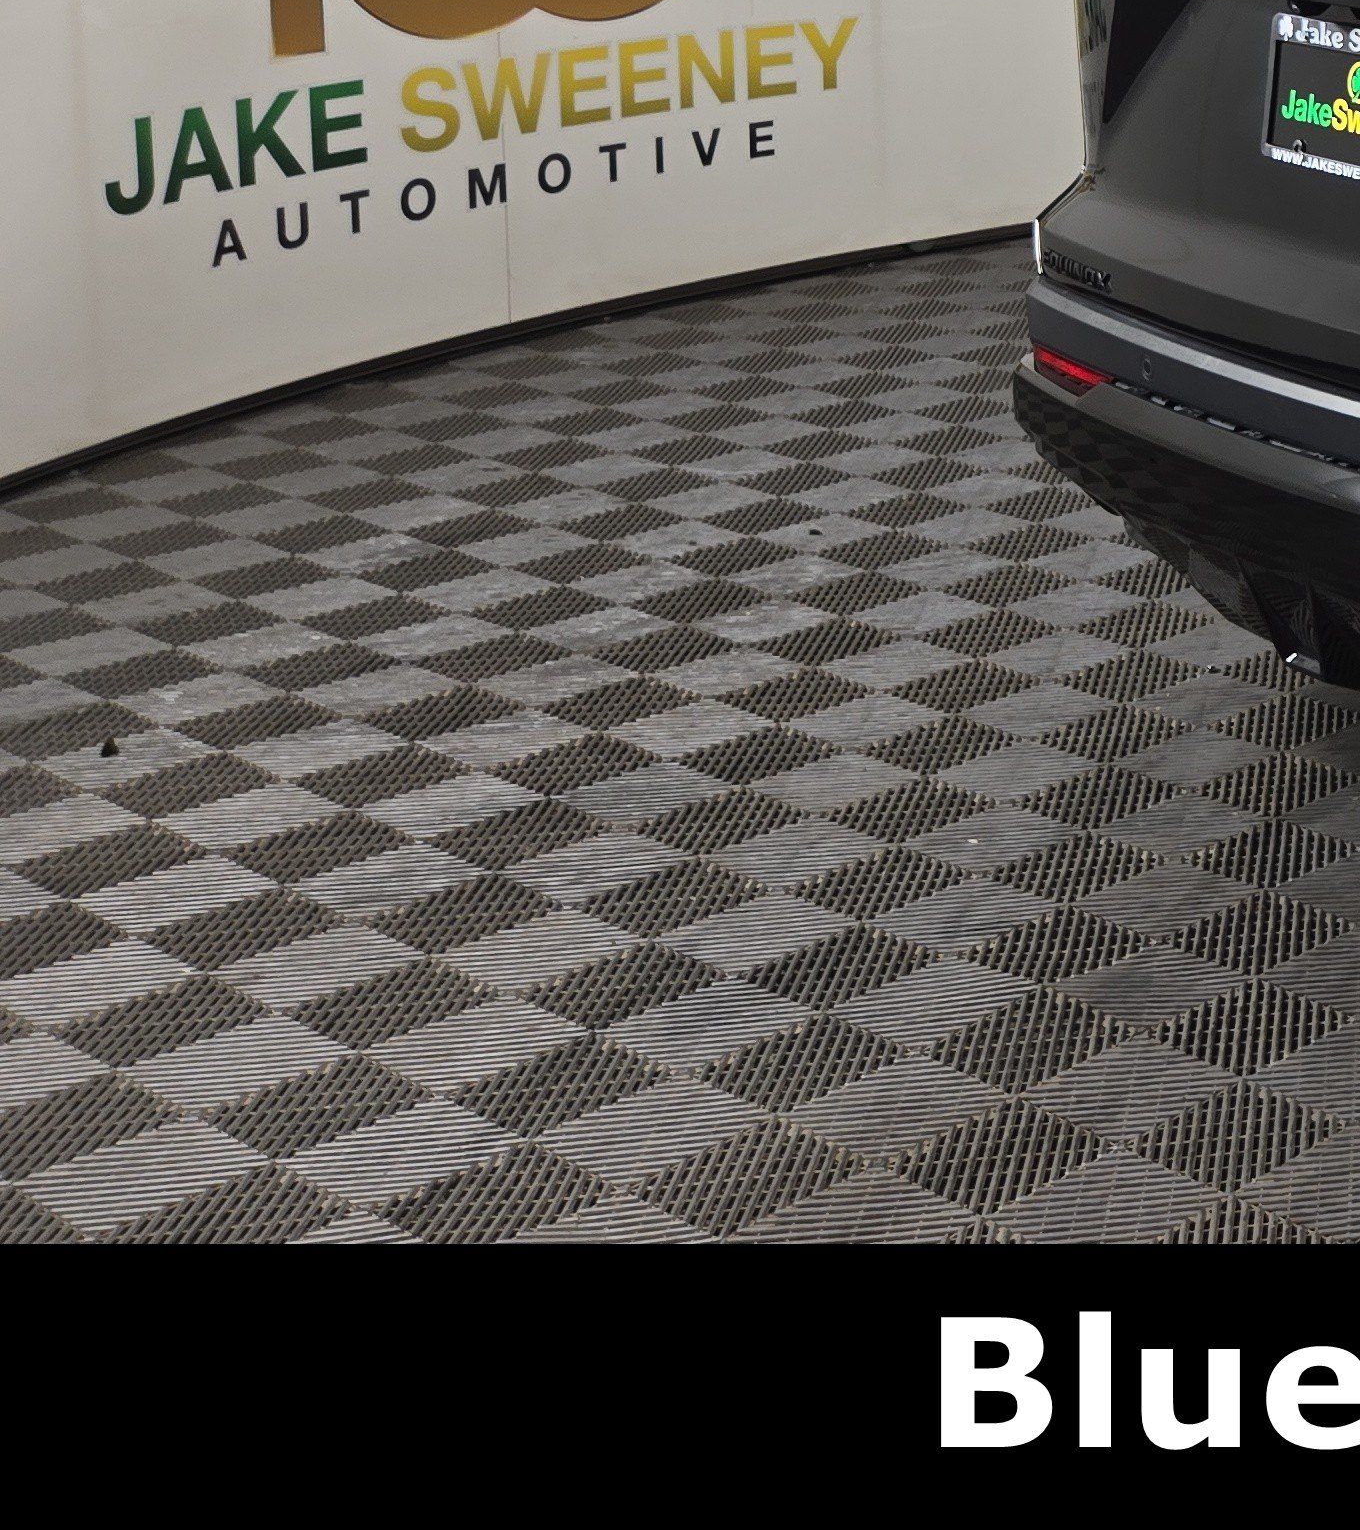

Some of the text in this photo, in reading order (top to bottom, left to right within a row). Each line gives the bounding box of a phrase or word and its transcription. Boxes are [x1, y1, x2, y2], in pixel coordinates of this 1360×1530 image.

[1295, 19, 1344, 49] Jake
[104, 16, 860, 216] JAKE SWEENEY
[211, 120, 777, 268] AUTOMOTIVE
